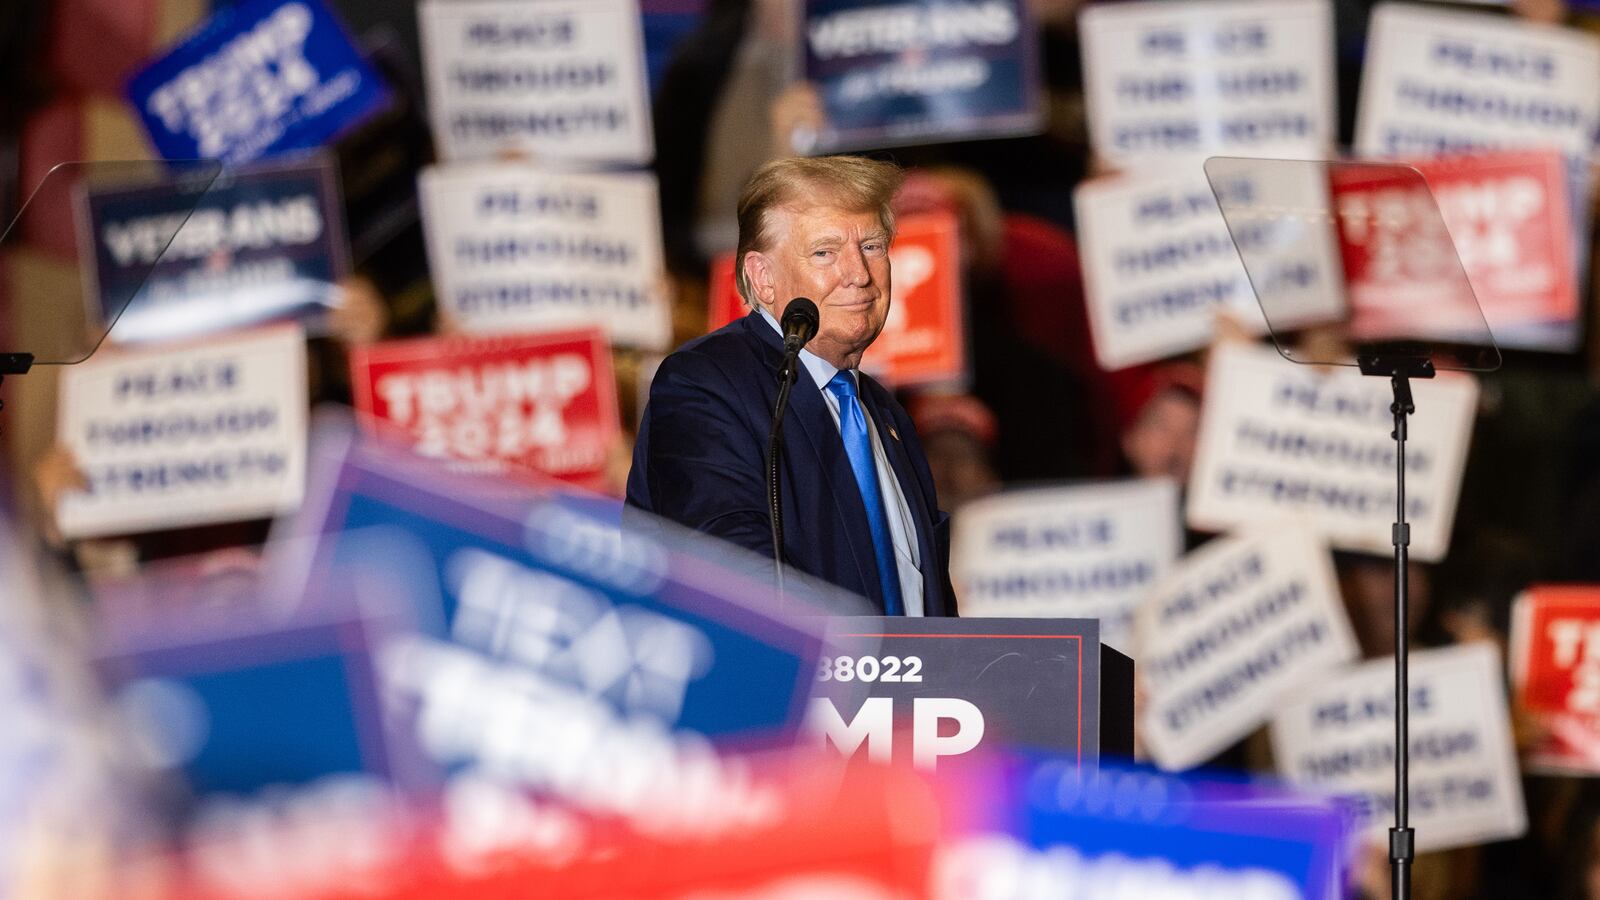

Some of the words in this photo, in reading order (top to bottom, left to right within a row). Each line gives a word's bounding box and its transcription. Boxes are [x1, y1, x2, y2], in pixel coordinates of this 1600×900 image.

[466, 19, 575, 46] PEACE
[808, 3, 1019, 60] VETERANS
[1142, 25, 1268, 55] PECE
[146, 2, 312, 133] TRUMP
[455, 62, 616, 92] THROUGH
[1433, 43, 1555, 78] PEACE
[1116, 69, 1306, 103] THRUGH
[1397, 79, 1583, 126] THROUGH
[476, 190, 600, 219] PEACE
[1339, 176, 1543, 244] TRUMP
[103, 195, 323, 266] VETERANS
[455, 238, 631, 266] THROUGH
[1115, 261, 1318, 326] STRENTH
[114, 360, 241, 398] PEACE
[376, 354, 591, 428] TRUMP
[85, 406, 279, 441] THROUGH
[416, 406, 567, 458] 2024
[994, 518, 1115, 548] PEACE
[1162, 552, 1263, 620] PEACE
